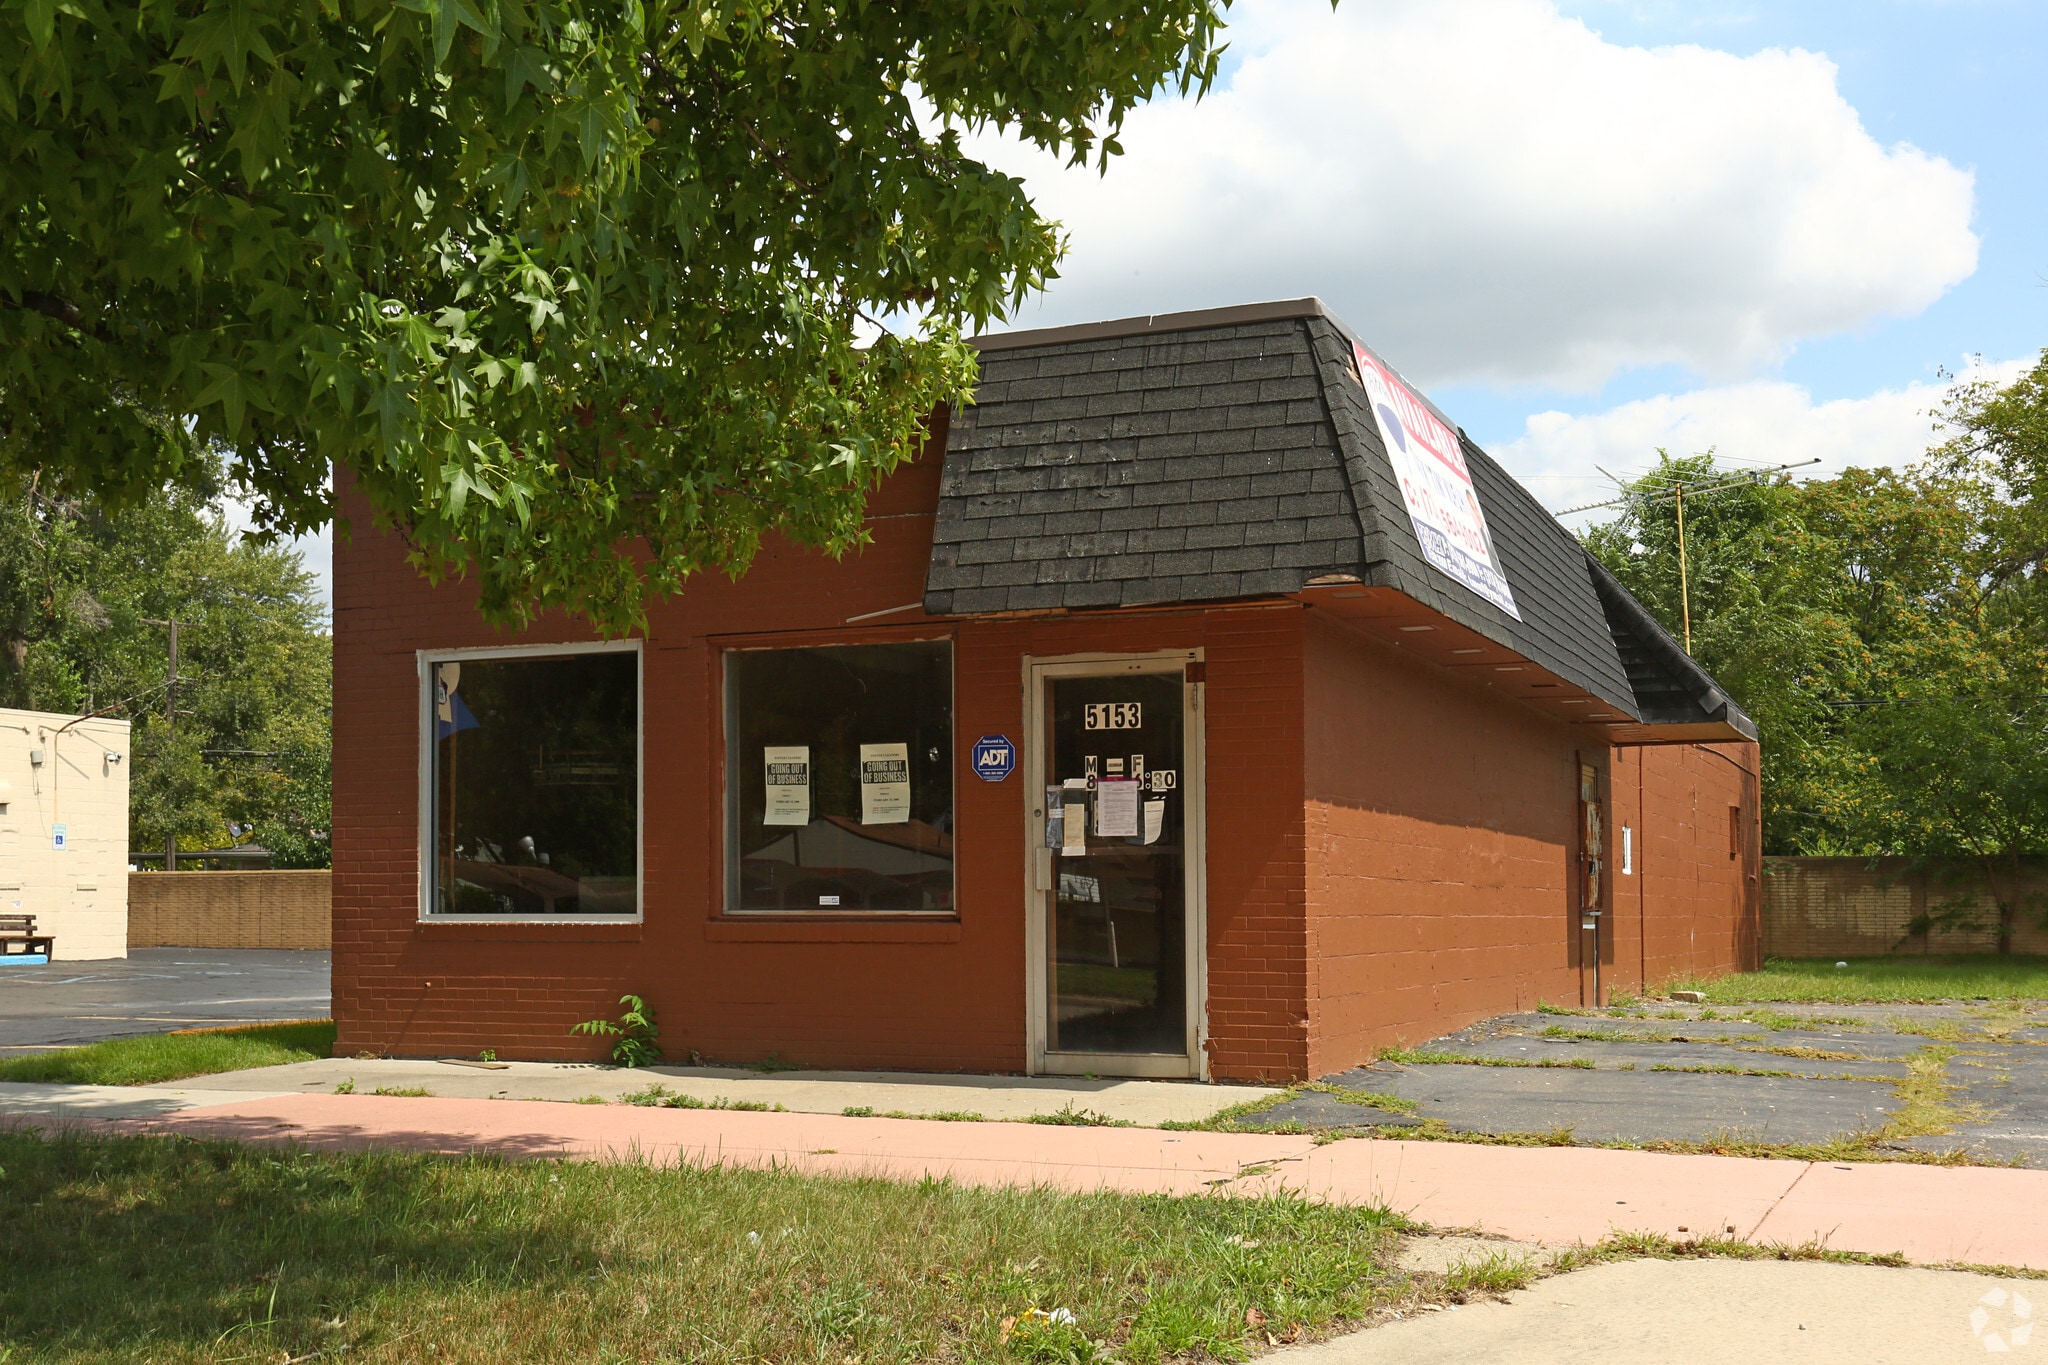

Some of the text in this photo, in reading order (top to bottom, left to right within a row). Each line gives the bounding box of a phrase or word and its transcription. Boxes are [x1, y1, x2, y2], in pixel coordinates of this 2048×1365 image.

[1388, 381, 1469, 477] AVAILABLE
[1087, 704, 1139, 728] 5153
[979, 750, 1008, 766] ADT
[1086, 757, 1096, 772] M
[1133, 756, 1142, 771] F
[770, 764, 803, 774] GOING OUT
[867, 761, 902, 772] GOING OUT
[768, 774, 807, 785] OF BUSINESS
[864, 772, 906, 783] OF BUSINESS
